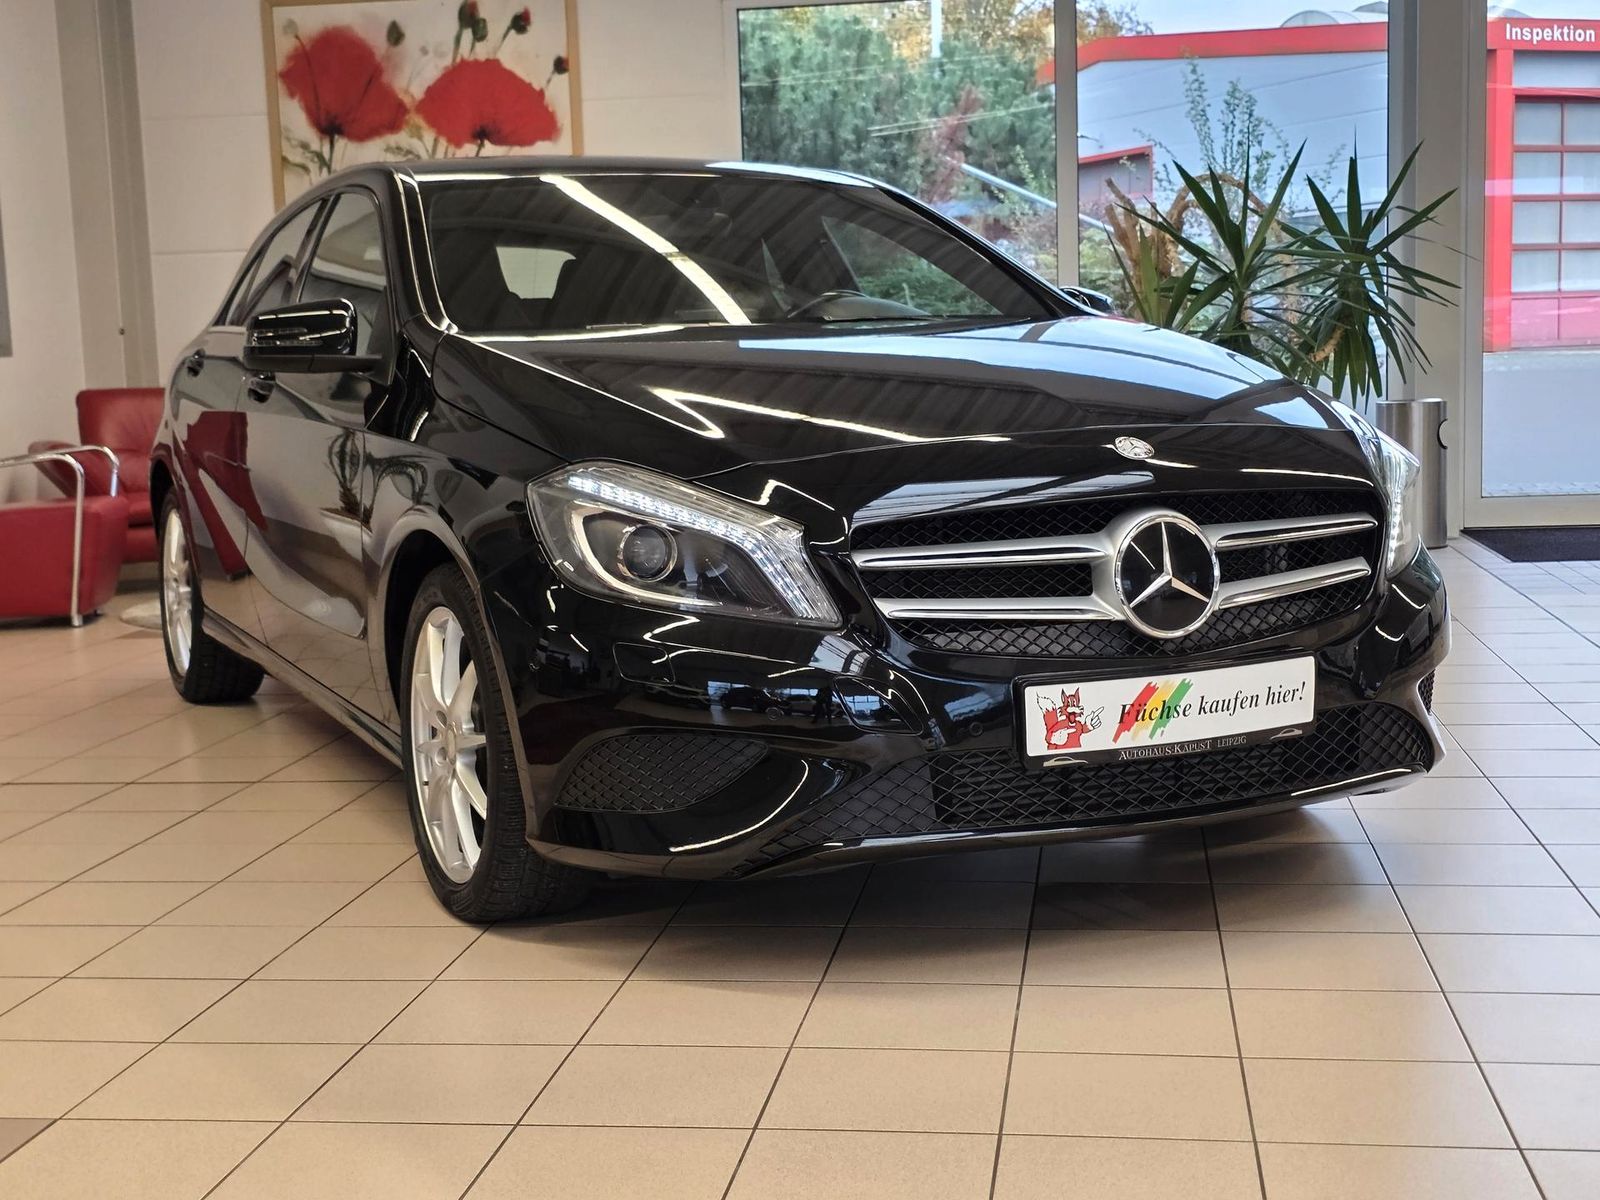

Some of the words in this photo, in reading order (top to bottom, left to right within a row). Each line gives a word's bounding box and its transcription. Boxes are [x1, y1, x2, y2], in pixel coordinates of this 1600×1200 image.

[1505, 23, 1595, 44] Inspektion
[1118, 700, 1192, 724] Füchse
[1198, 690, 1260, 716] kaufen
[1266, 681, 1306, 705] hier!
[1217, 736, 1247, 748] LEIPZIG
